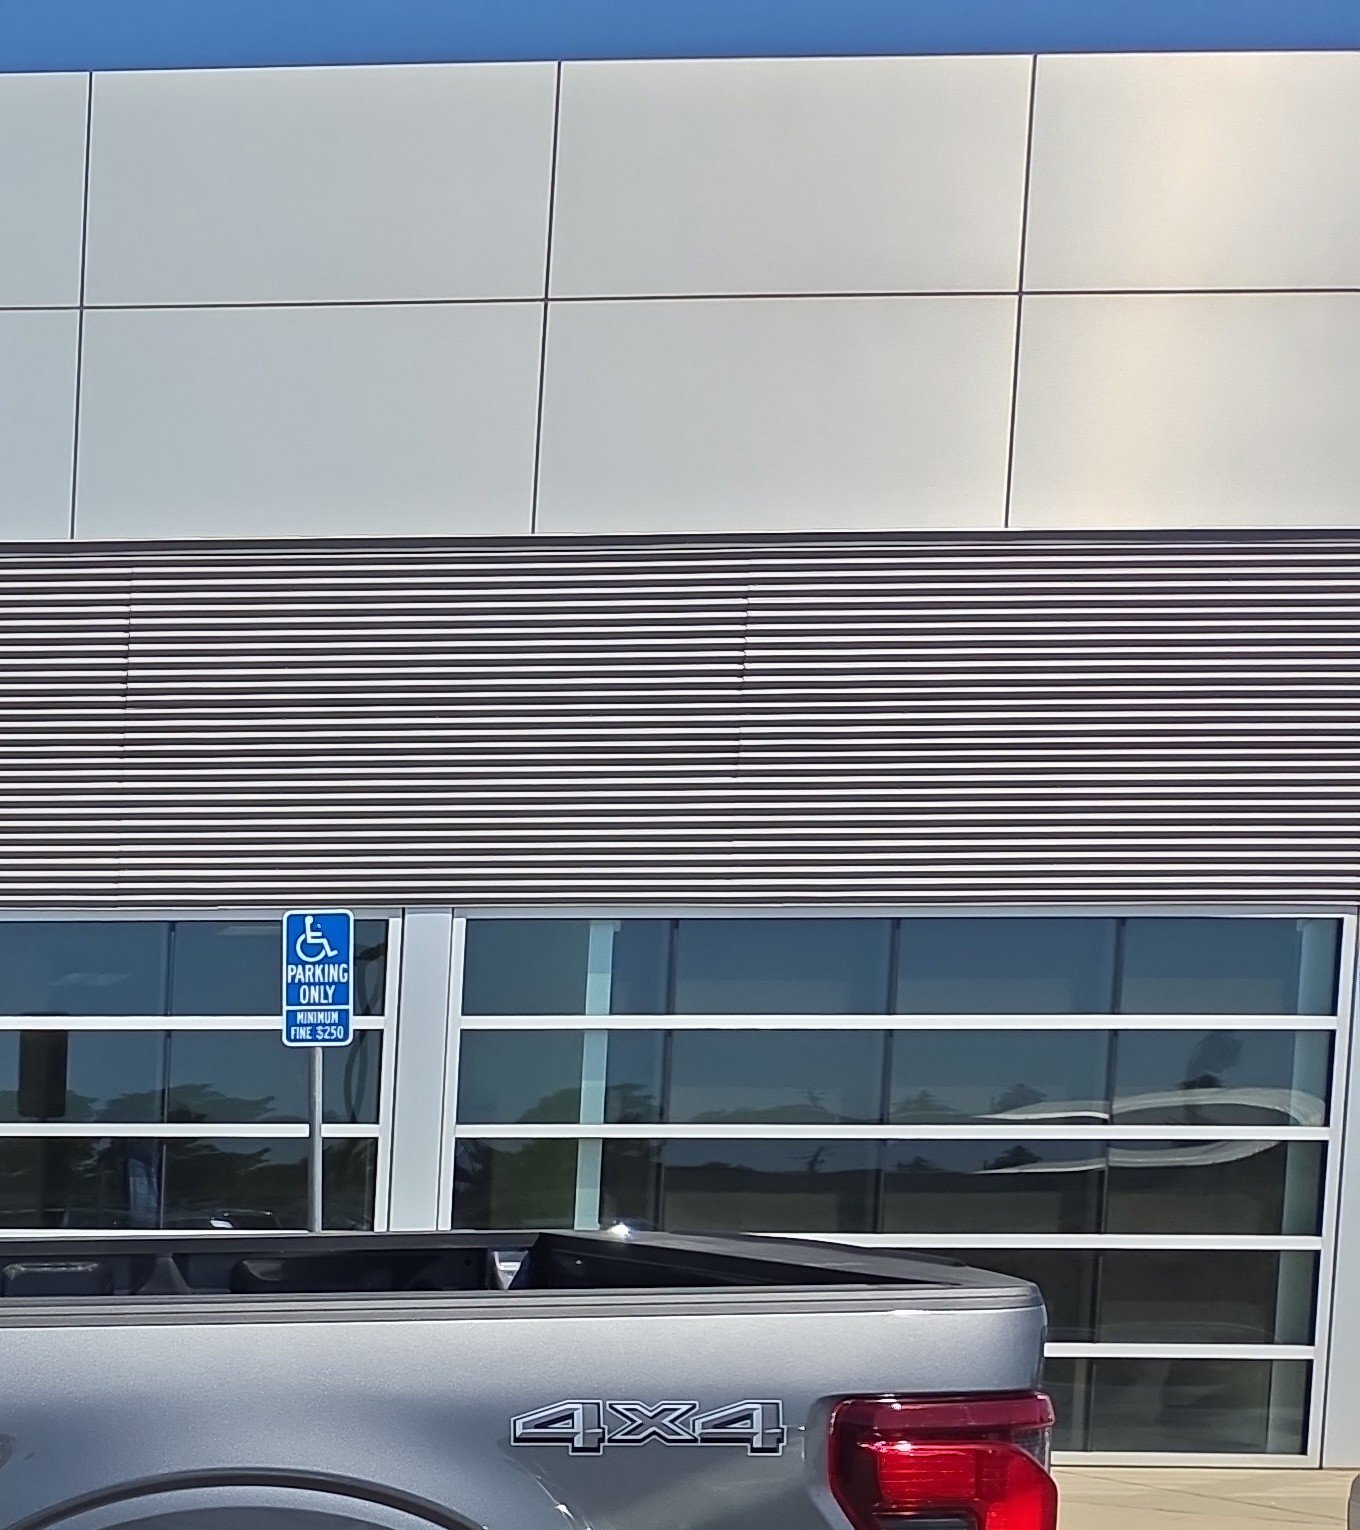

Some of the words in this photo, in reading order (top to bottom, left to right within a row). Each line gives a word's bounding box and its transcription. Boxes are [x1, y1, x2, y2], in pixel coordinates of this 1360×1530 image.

[287, 963, 349, 984] PARKING
[299, 984, 336, 1004] ONLY
[296, 1011, 339, 1024] MINIMUM
[290, 1026, 312, 1040] FINE
[316, 1025, 344, 1041] $250
[510, 1399, 787, 1456] 4X4
